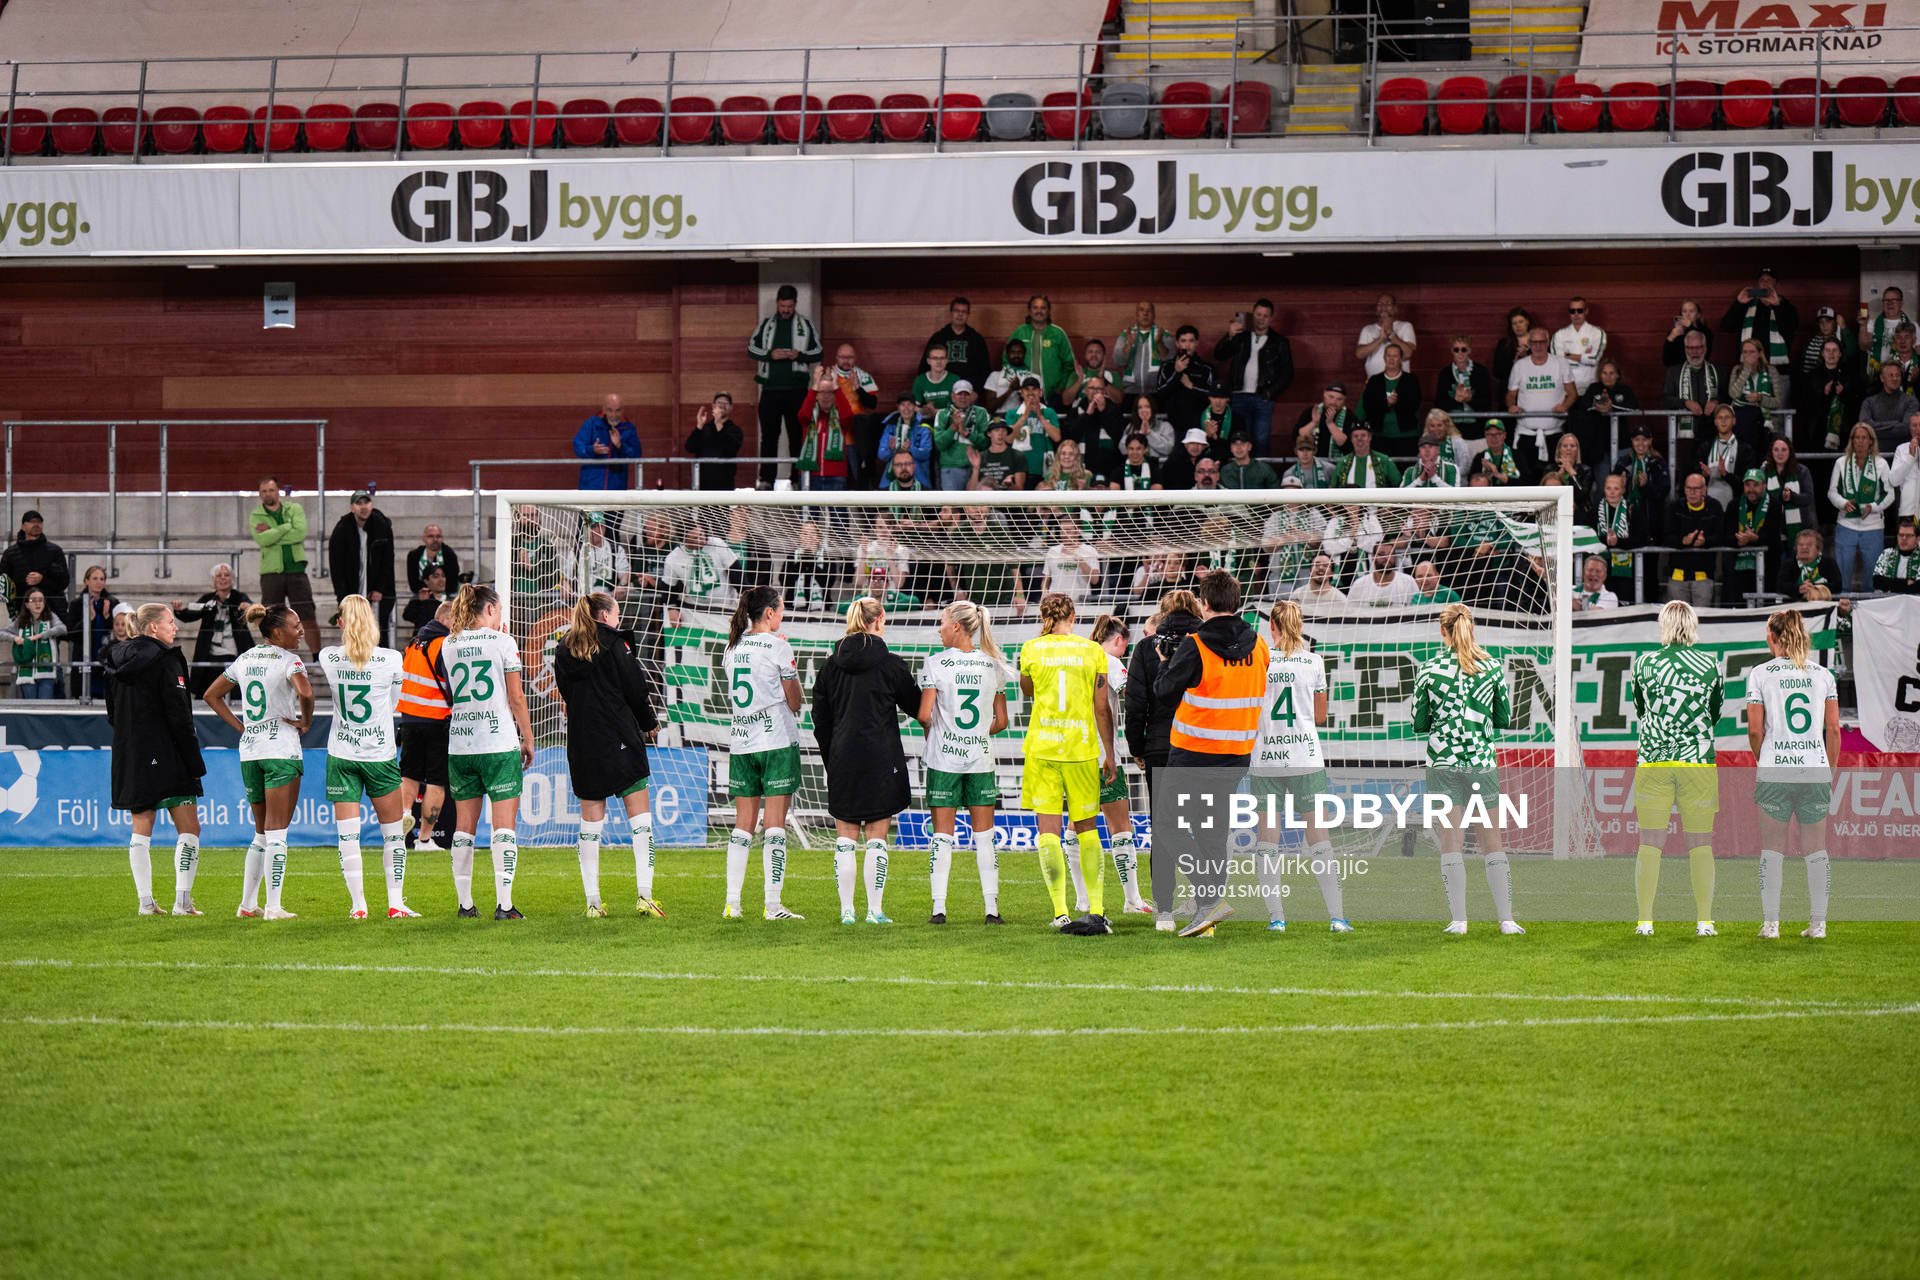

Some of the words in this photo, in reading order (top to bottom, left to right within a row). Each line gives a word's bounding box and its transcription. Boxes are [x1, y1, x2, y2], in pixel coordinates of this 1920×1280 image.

[1657, 0, 1887, 37] MAXI
[1656, 41, 1690, 56] ICA
[1697, 34, 1883, 55] STORMARKNAD
[391, 169, 548, 243] GBJ
[559, 182, 697, 241] bygg.
[1012, 160, 1177, 235] GBJ
[1188, 173, 1333, 233] bygg.
[1661, 151, 1833, 227] GBJ
[456, 646, 483, 658] WESTIN
[337, 670, 372, 681] VINBERG
[450, 660, 495, 704] 23
[732, 667, 754, 709] 5
[955, 673, 982, 685] ÖKVIST
[1058, 670, 1067, 713] 1
[1268, 672, 1295, 683] SØRBO
[1780, 678, 1813, 690] RODDAR
[246, 680, 267, 722] 9
[338, 683, 373, 724] 13
[732, 710, 771, 725] ARGINAL
[954, 689, 980, 730] 3
[1271, 686, 1297, 728] 4
[1784, 692, 1812, 735] 6
[942, 744, 970, 759] BANK
[1260, 750, 1291, 761] BANK
[1774, 740, 1823, 751] MARGINA
[1774, 755, 1806, 765] BANK
[1828, 771, 1920, 816] VEA
[58, 799, 99, 831] Följ
[1834, 821, 1878, 837] VÄXJÖ
